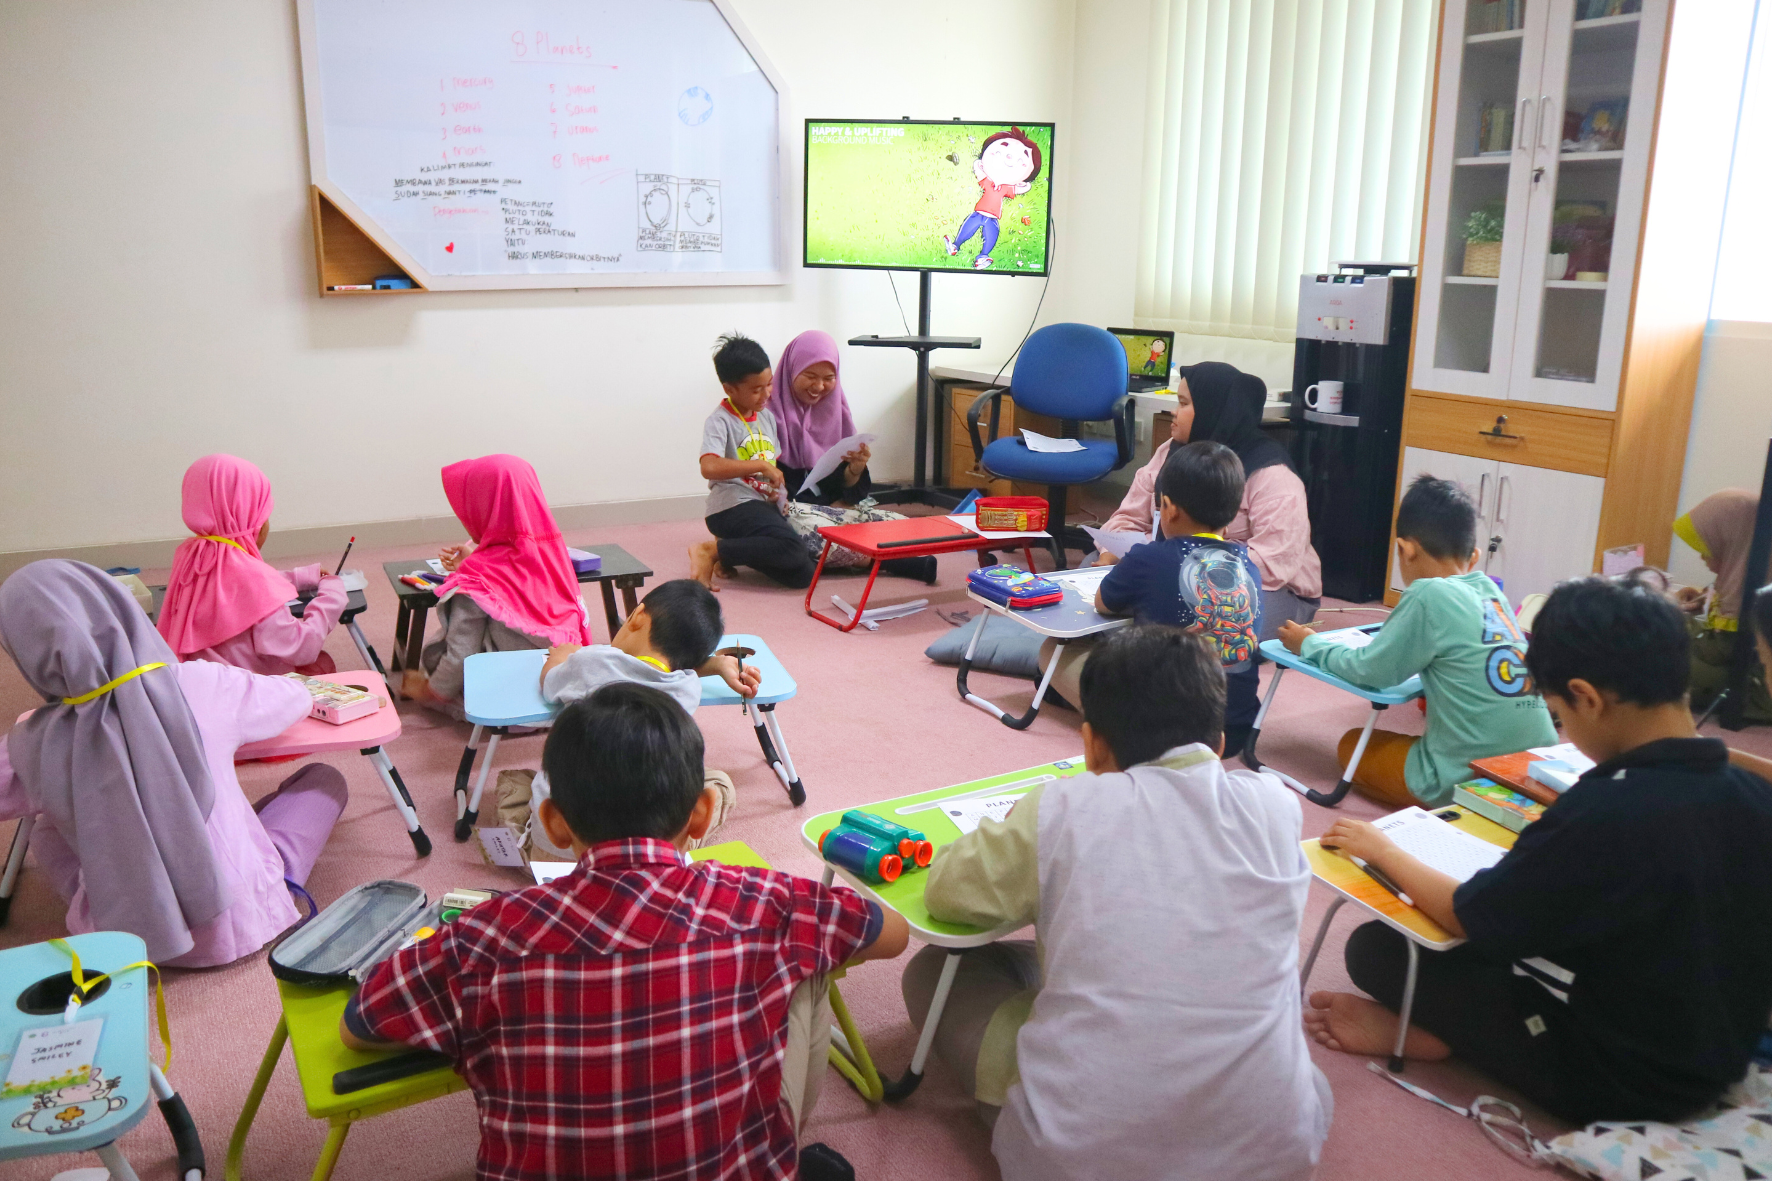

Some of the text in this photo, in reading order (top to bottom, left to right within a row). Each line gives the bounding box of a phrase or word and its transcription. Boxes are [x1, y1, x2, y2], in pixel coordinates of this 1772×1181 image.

[511, 30, 592, 58] 8 Planets
[550, 102, 557, 114] 6
[550, 122, 557, 139] 7
[811, 126, 905, 137] HAPPY & UPLIFTING
[812, 135, 894, 145] BACKGROUND MUSIC
[552, 153, 562, 169] 8
[420, 163, 457, 173] KALIMAT
[394, 178, 432, 187] MEMBAWA
[434, 178, 446, 187] VAS
[394, 190, 420, 198] SUDAH
[530, 209, 555, 217] TIDAK
[505, 217, 552, 228] MELAKUKAN
[504, 227, 576, 238] SATU PERATURAN
[986, 799, 1017, 808] PLAN
[31, 1039, 82, 1055] JASMINE
[31, 1051, 73, 1064] SMILEY
